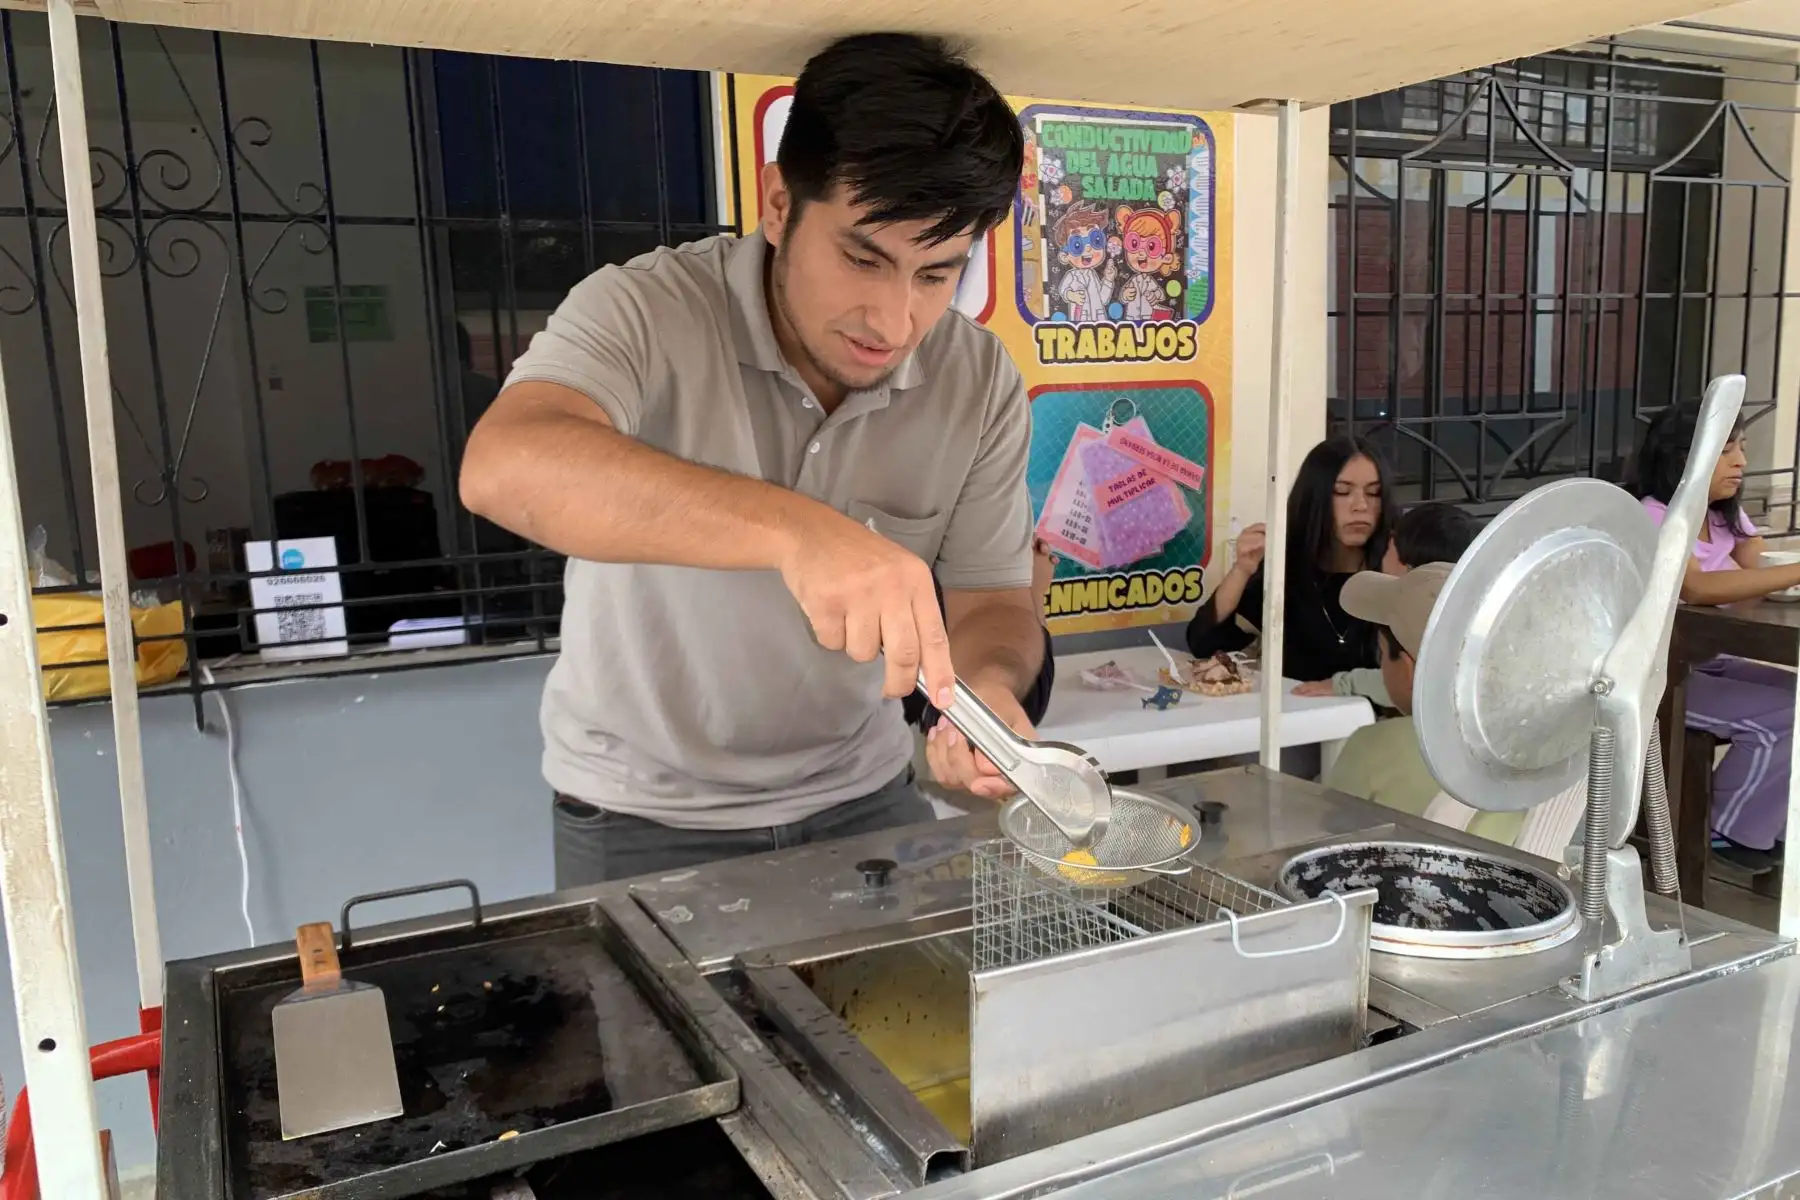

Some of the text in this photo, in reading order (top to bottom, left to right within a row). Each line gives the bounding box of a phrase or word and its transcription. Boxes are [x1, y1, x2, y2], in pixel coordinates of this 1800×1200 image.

[1041, 123, 1193, 154] CONDUCTIVIDAD
[1066, 151, 1158, 178] DEL AGUA
[1081, 175, 1157, 201] SALADA
[1036, 324, 1197, 363] TRABAJOS
[1108, 469, 1147, 493] TABLAS DE
